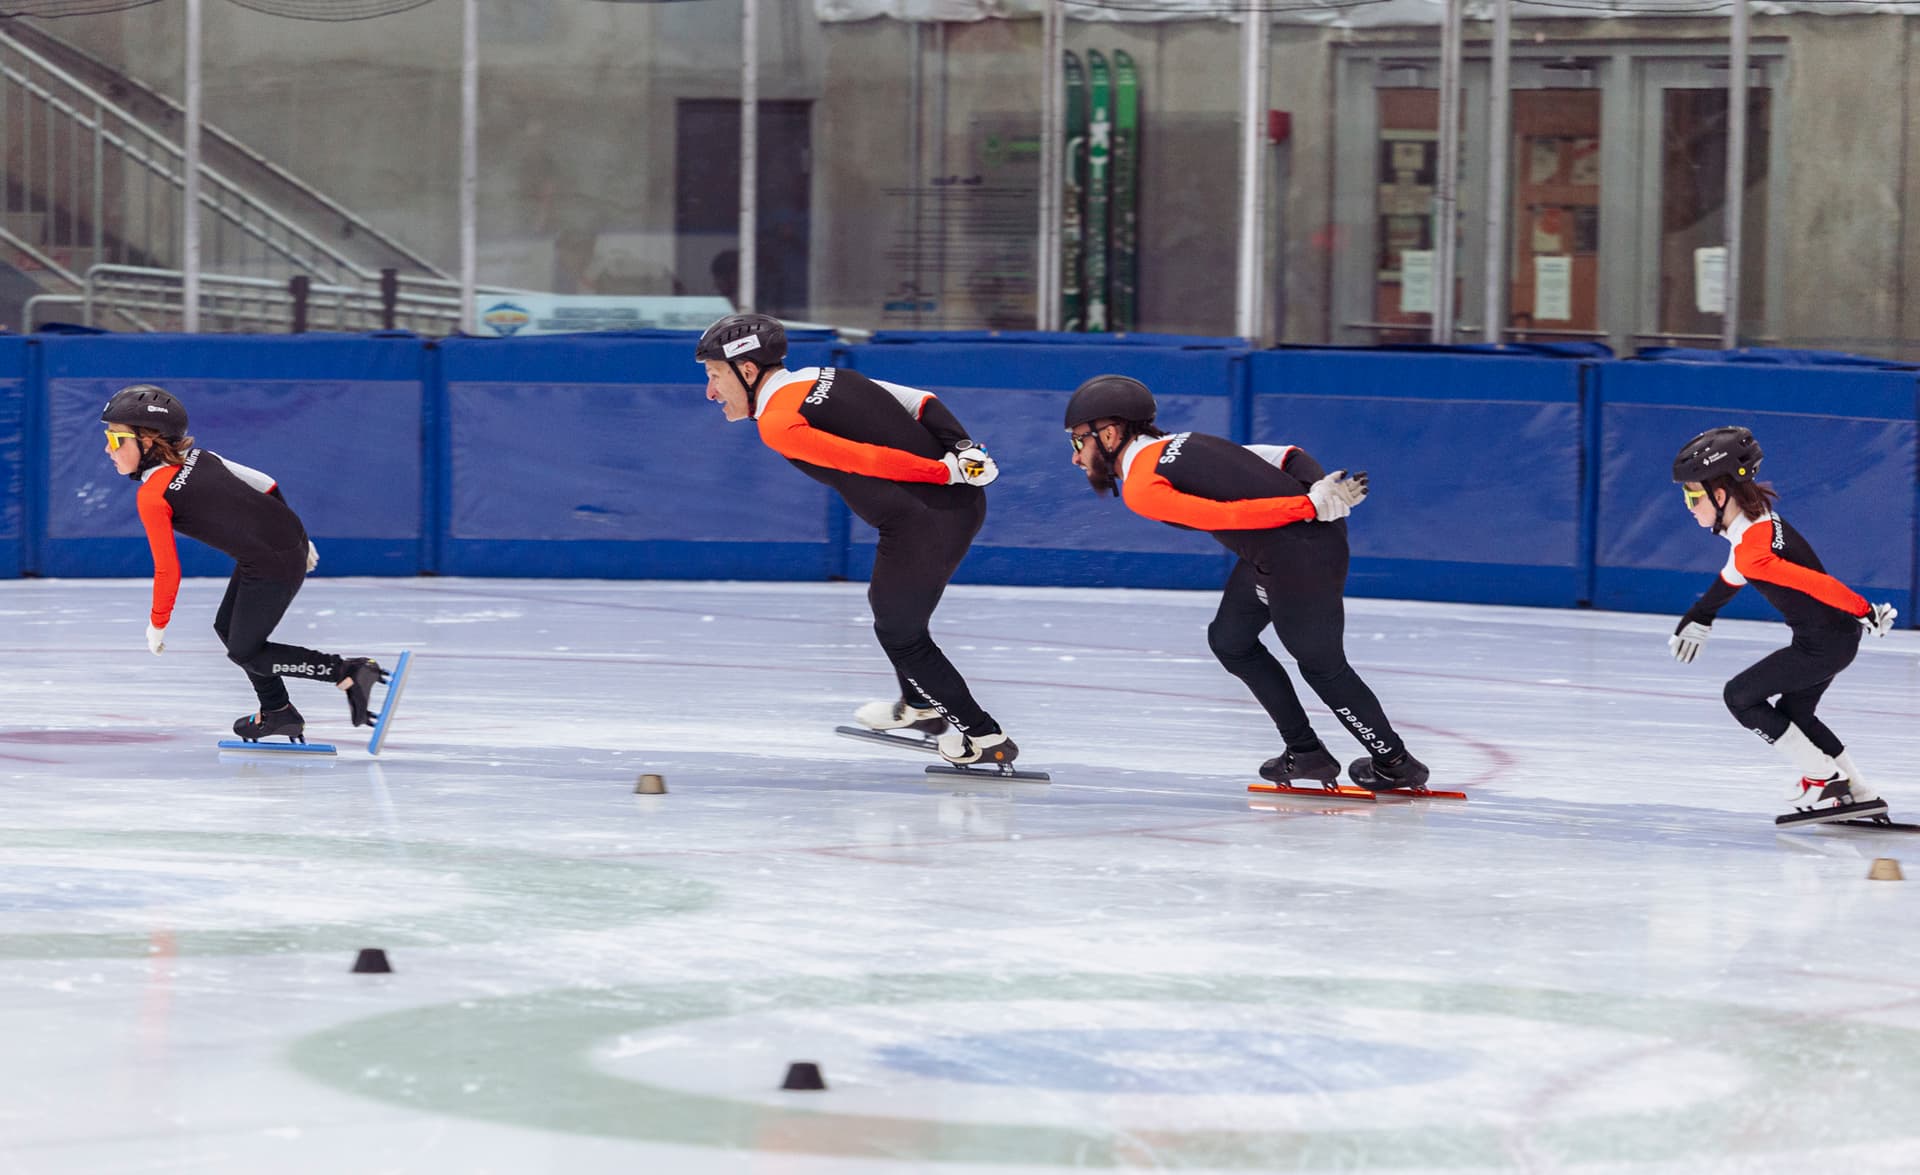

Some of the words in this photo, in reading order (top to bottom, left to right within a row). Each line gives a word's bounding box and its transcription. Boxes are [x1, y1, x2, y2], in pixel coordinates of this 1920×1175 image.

[805, 380, 834, 405] Speed
[168, 464, 193, 491] Speed
[1771, 520, 1785, 550] Speed
[272, 661, 316, 676] Speed
[907, 678, 948, 714] Speed
[1335, 706, 1377, 741] Speed
[1370, 740, 1393, 754] PC
